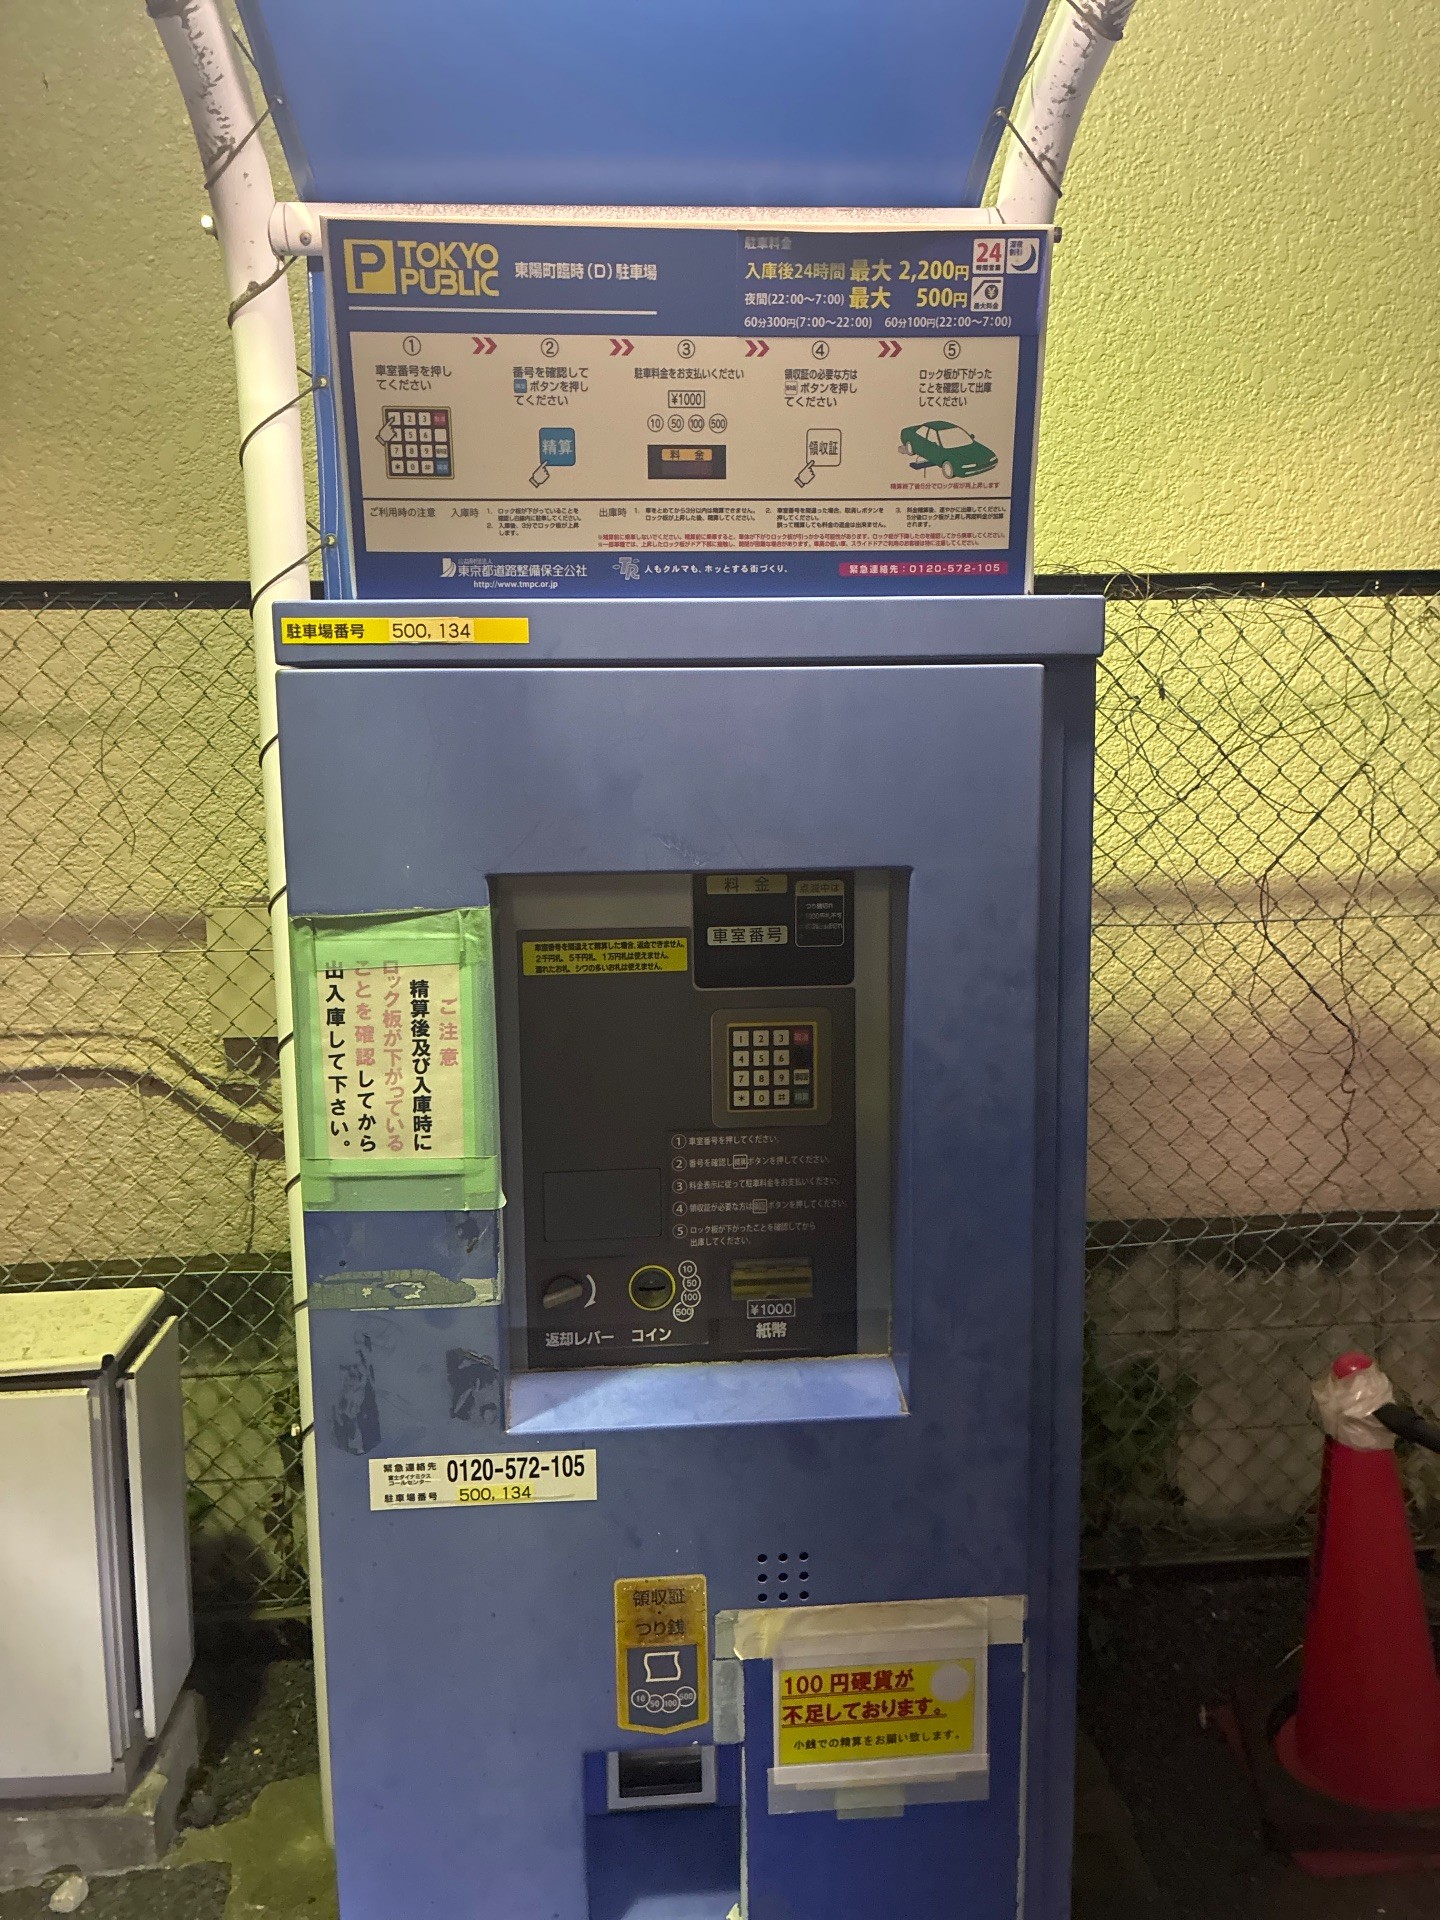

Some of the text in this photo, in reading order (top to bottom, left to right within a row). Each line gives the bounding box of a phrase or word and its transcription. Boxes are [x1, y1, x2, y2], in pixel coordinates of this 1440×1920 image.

[743, 236, 793, 251] 駐車料金
[397, 240, 500, 270] TOKYO
[976, 242, 1002, 263] 24
[744, 259, 970, 283] 入庫後24時間 最大 2,200円
[400, 267, 501, 297] PUBLIC
[848, 286, 892, 310] 最大
[915, 287, 969, 309] 500円
[973, 302, 999, 310] 最大料金
[375, 364, 453, 378] 車室番号を押し
[512, 366, 589, 380] 番号を確認して
[633, 367, 745, 380] 駐車料金をお支払いください
[783, 368, 858, 381] 領収証の必要な方は
[918, 368, 993, 381] ロック板が下がった
[376, 379, 432, 392] てください
[529, 380, 589, 393] ボタンを押し
[800, 382, 858, 394] ボタンを押し
[918, 382, 992, 394] ことを確認して出庫
[513, 393, 569, 407] てください
[670, 392, 702, 406] ¥1000
[783, 396, 838, 408] てください
[918, 396, 967, 408] してください
[650, 418, 661, 429] 10
[670, 418, 682, 429] 50
[689, 418, 704, 429] 100
[710, 418, 726, 429] 500
[542, 438, 573, 455] 精算
[808, 440, 839, 456] 領収証
[369, 507, 436, 518] ご利用時の注意
[451, 507, 479, 518] 入庫時
[599, 507, 627, 518] 出庫時
[776, 514, 820, 522] 押してください。
[498, 529, 520, 537] します。
[457, 564, 588, 578] 東京都道路整備保全公社
[473, 579, 559, 590] http://www.tmpc.or.jp
[286, 623, 365, 639] 駐車場番号
[712, 927, 783, 944] 車室番号
[438, 998, 460, 1067] ご注意
[324, 961, 351, 1148] 出入庫して下さい。
[353, 959, 377, 1153] ことを確認してから
[382, 959, 405, 1152] ロック板が下がっている
[409, 979, 433, 1152] 精算後及び入庫時に
[690, 1237, 752, 1248] 出庫してください。
[682, 1265, 694, 1274] 10
[686, 1279, 697, 1288] 50
[682, 1293, 698, 1302] 100
[675, 1307, 693, 1317] 500
[750, 1302, 792, 1316] ¥1000
[631, 1328, 672, 1343] コイン
[755, 1321, 788, 1339] 紙幣
[545, 1331, 615, 1348] 返却レバー
[383, 1461, 437, 1474] 緊急連絡先
[446, 1454, 585, 1483] 0120-572-105
[388, 1479, 432, 1487] コールセンター
[384, 1491, 438, 1504] 駐車場番号
[632, 1588, 686, 1608] 領収証
[635, 1618, 686, 1637] つり銭
[784, 1667, 914, 1695] 100 円硬貨が
[636, 1695, 646, 1703] 10
[650, 1699, 660, 1708] 50
[664, 1699, 677, 1708] 100
[782, 1695, 942, 1726] 不足しております。
[793, 1729, 961, 1750] 小銭での精算をお願い致します。
